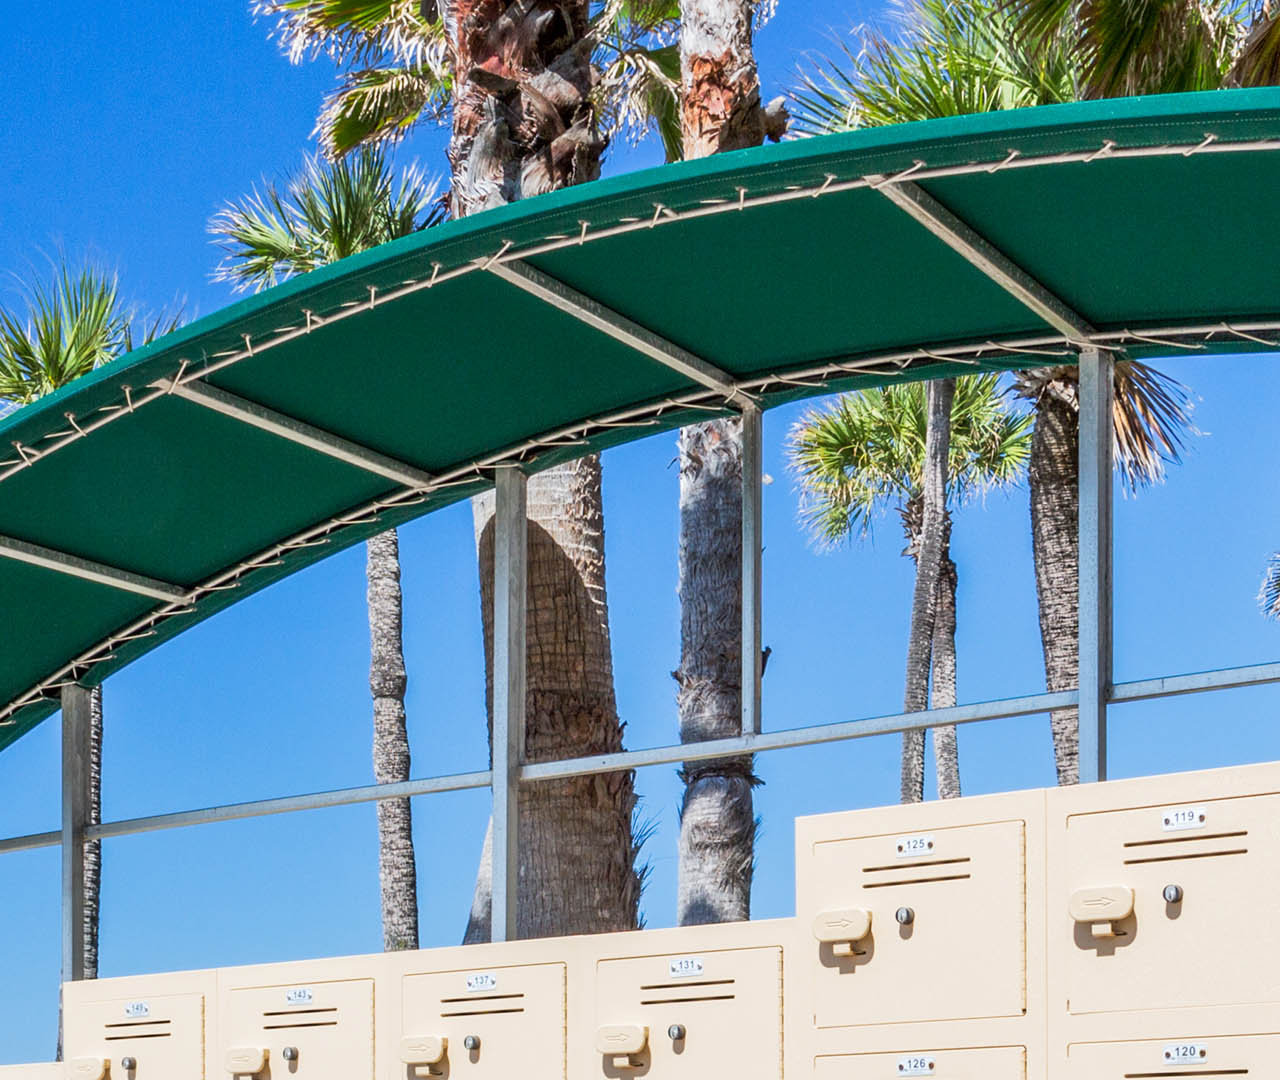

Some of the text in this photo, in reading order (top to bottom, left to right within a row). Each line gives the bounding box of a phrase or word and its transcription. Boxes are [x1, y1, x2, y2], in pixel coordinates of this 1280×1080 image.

[1175, 811, 1194, 822] 119
[907, 839, 925, 849] 125
[679, 960, 694, 969] 131
[475, 976, 489, 984] 137
[294, 990, 306, 998] 143
[1175, 1046, 1196, 1056] 120
[908, 1058, 926, 1068] 126
